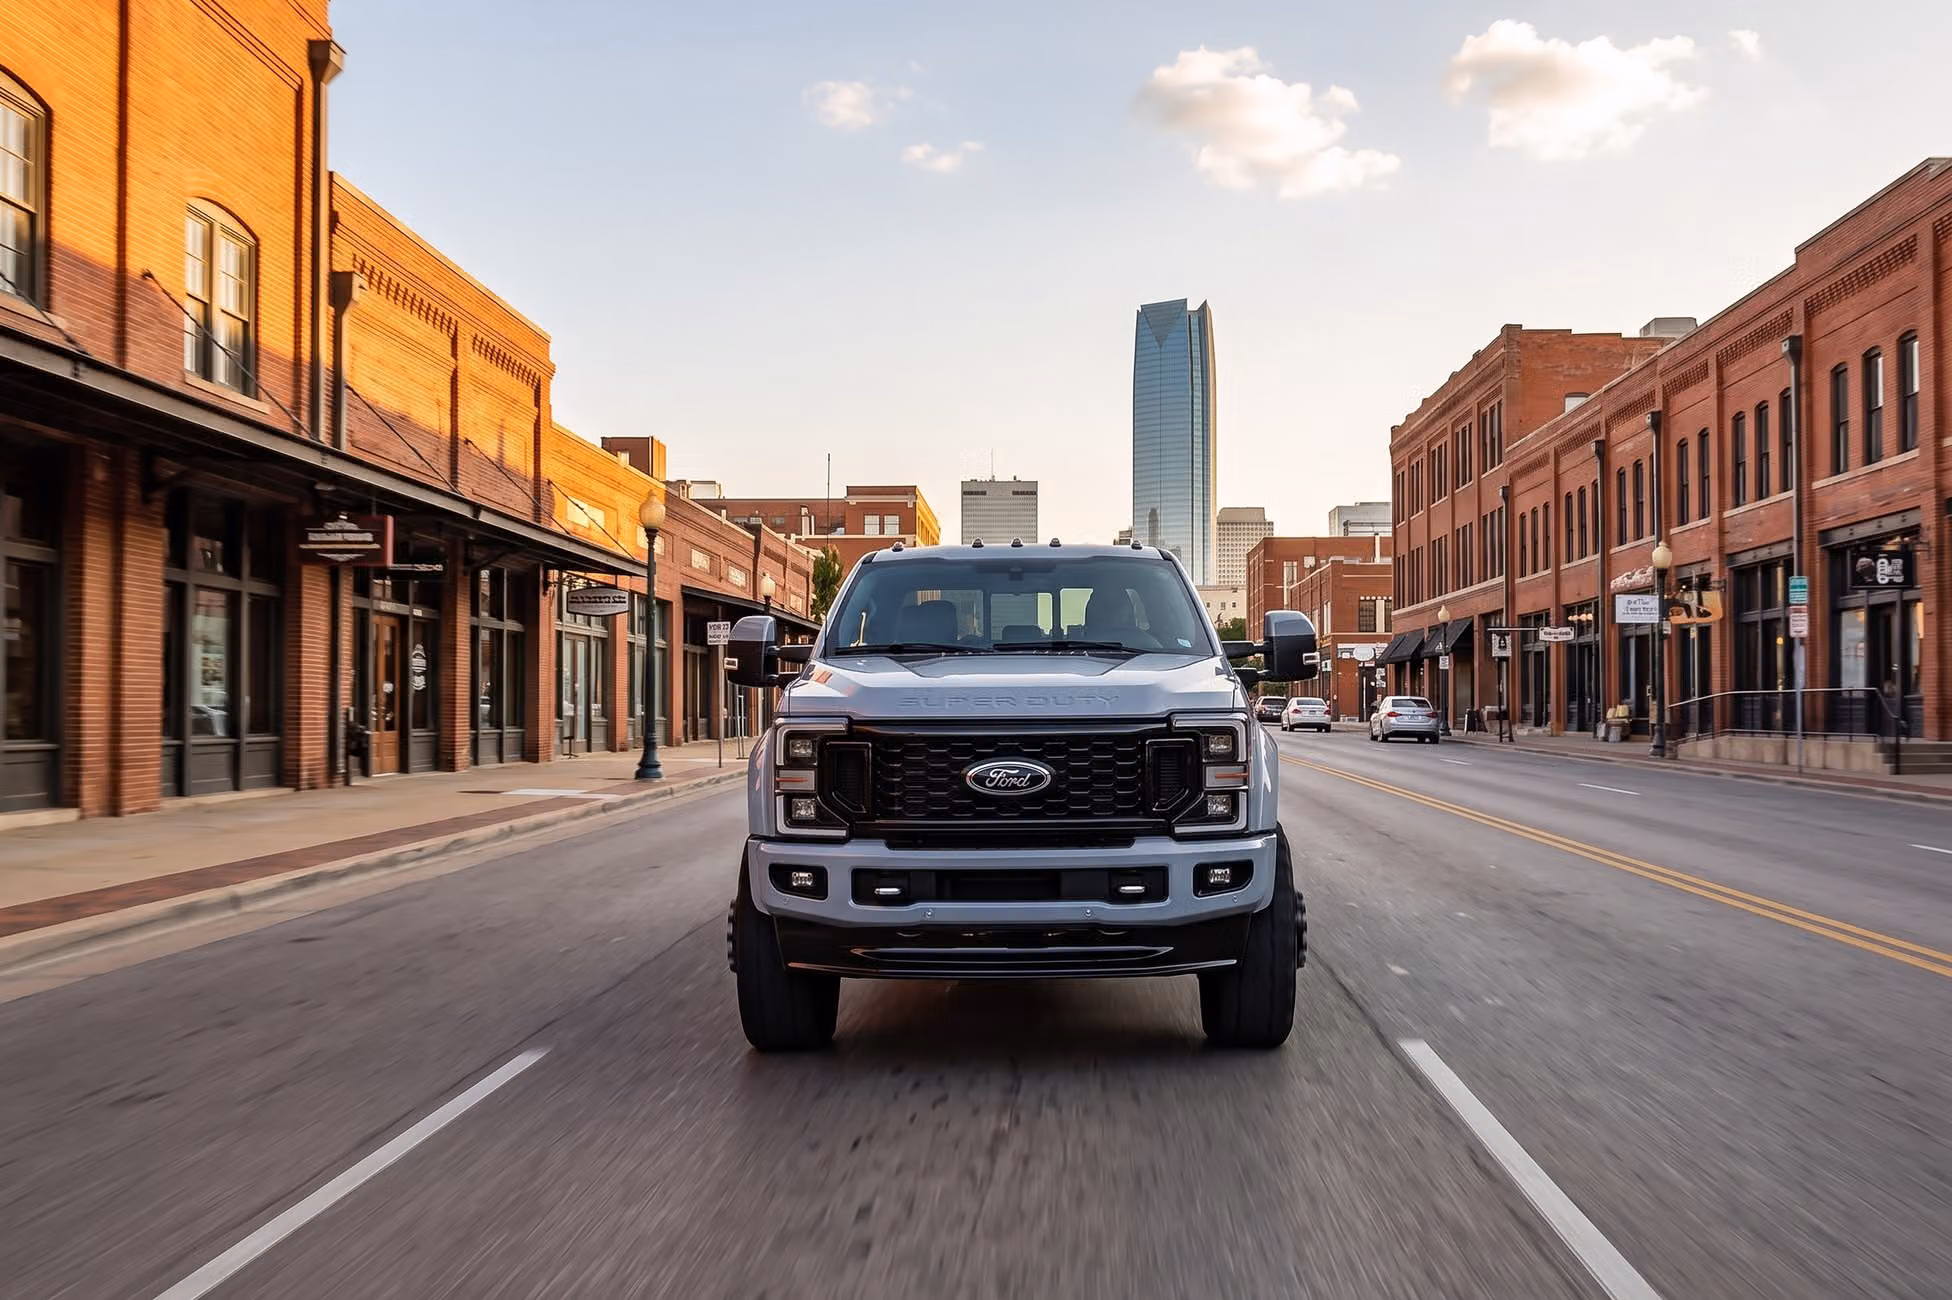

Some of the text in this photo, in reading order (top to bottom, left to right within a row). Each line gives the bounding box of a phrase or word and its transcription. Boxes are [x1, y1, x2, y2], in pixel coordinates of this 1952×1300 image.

[898, 695, 1120, 708] SUPER DUTY
[985, 768, 1031, 787] Ford
